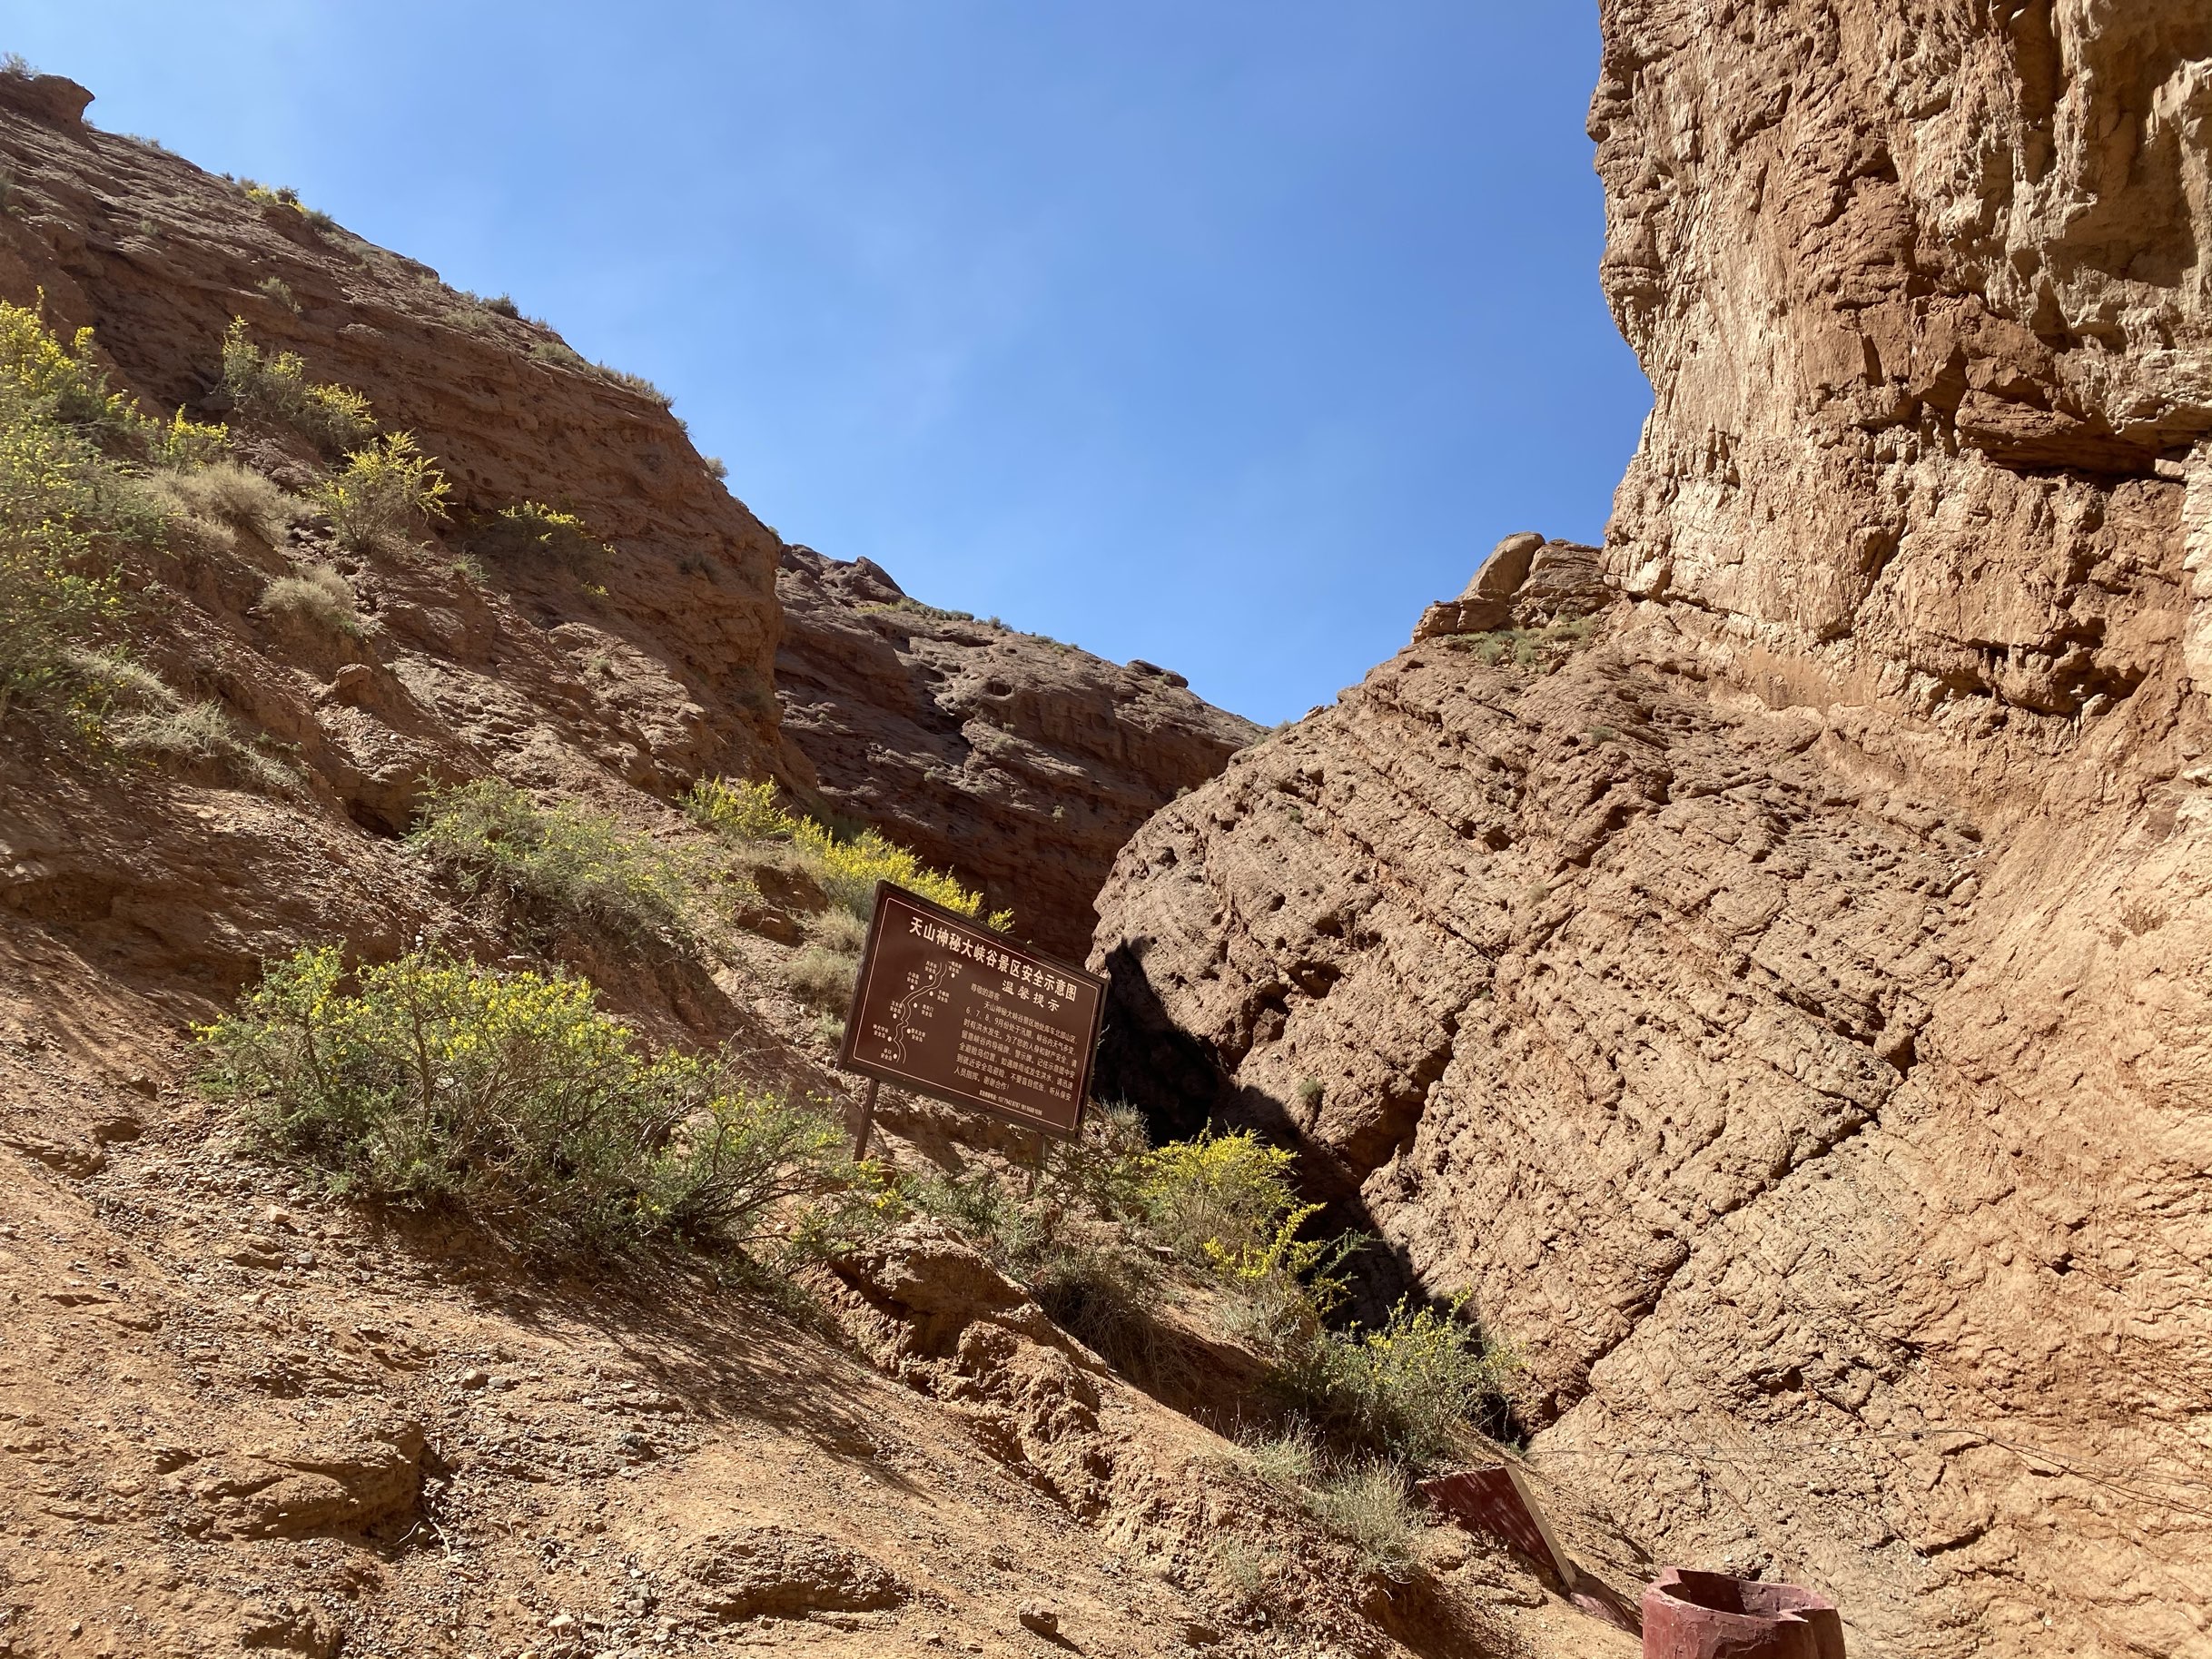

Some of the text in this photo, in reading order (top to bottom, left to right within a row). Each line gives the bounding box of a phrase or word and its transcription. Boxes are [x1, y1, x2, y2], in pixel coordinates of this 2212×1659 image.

[909, 916, 1077, 1002] 天山神秘大峡谷景区安全示意图
[1002, 980, 1060, 1012] 温馨提示
